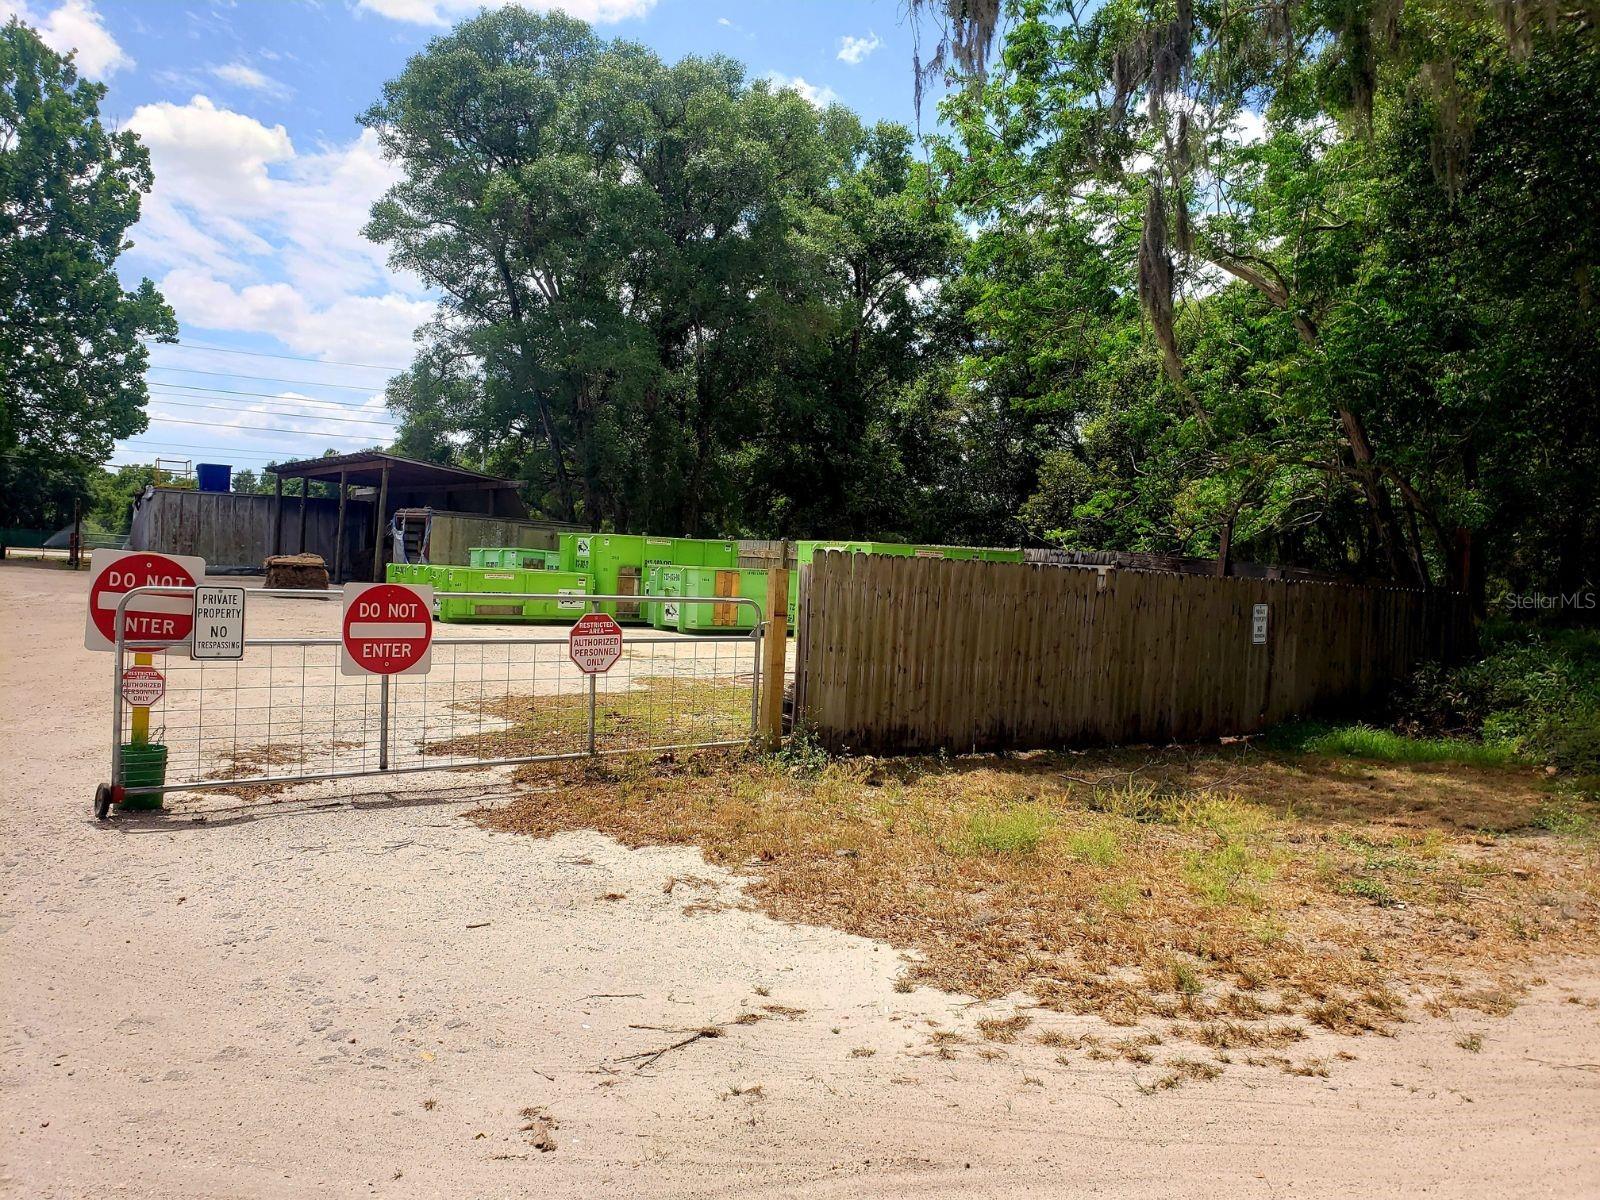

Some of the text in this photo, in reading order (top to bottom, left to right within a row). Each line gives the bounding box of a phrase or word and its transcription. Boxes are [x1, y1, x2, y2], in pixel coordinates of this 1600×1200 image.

[108, 571, 187, 588] DO NOT
[202, 594, 238, 605] PRIVATE
[197, 608, 242, 619] PROPERTY
[359, 602, 418, 618] DO NOT
[112, 616, 175, 635] NTER
[579, 621, 614, 629] RESTRICTED
[210, 625, 228, 638] NO
[197, 641, 240, 649] TRESPASSING
[573, 637, 619, 647] AUTHORIZED
[362, 643, 412, 658] ENTER
[574, 647, 617, 657] PERSONNEL
[586, 658, 605, 667] ONLY
